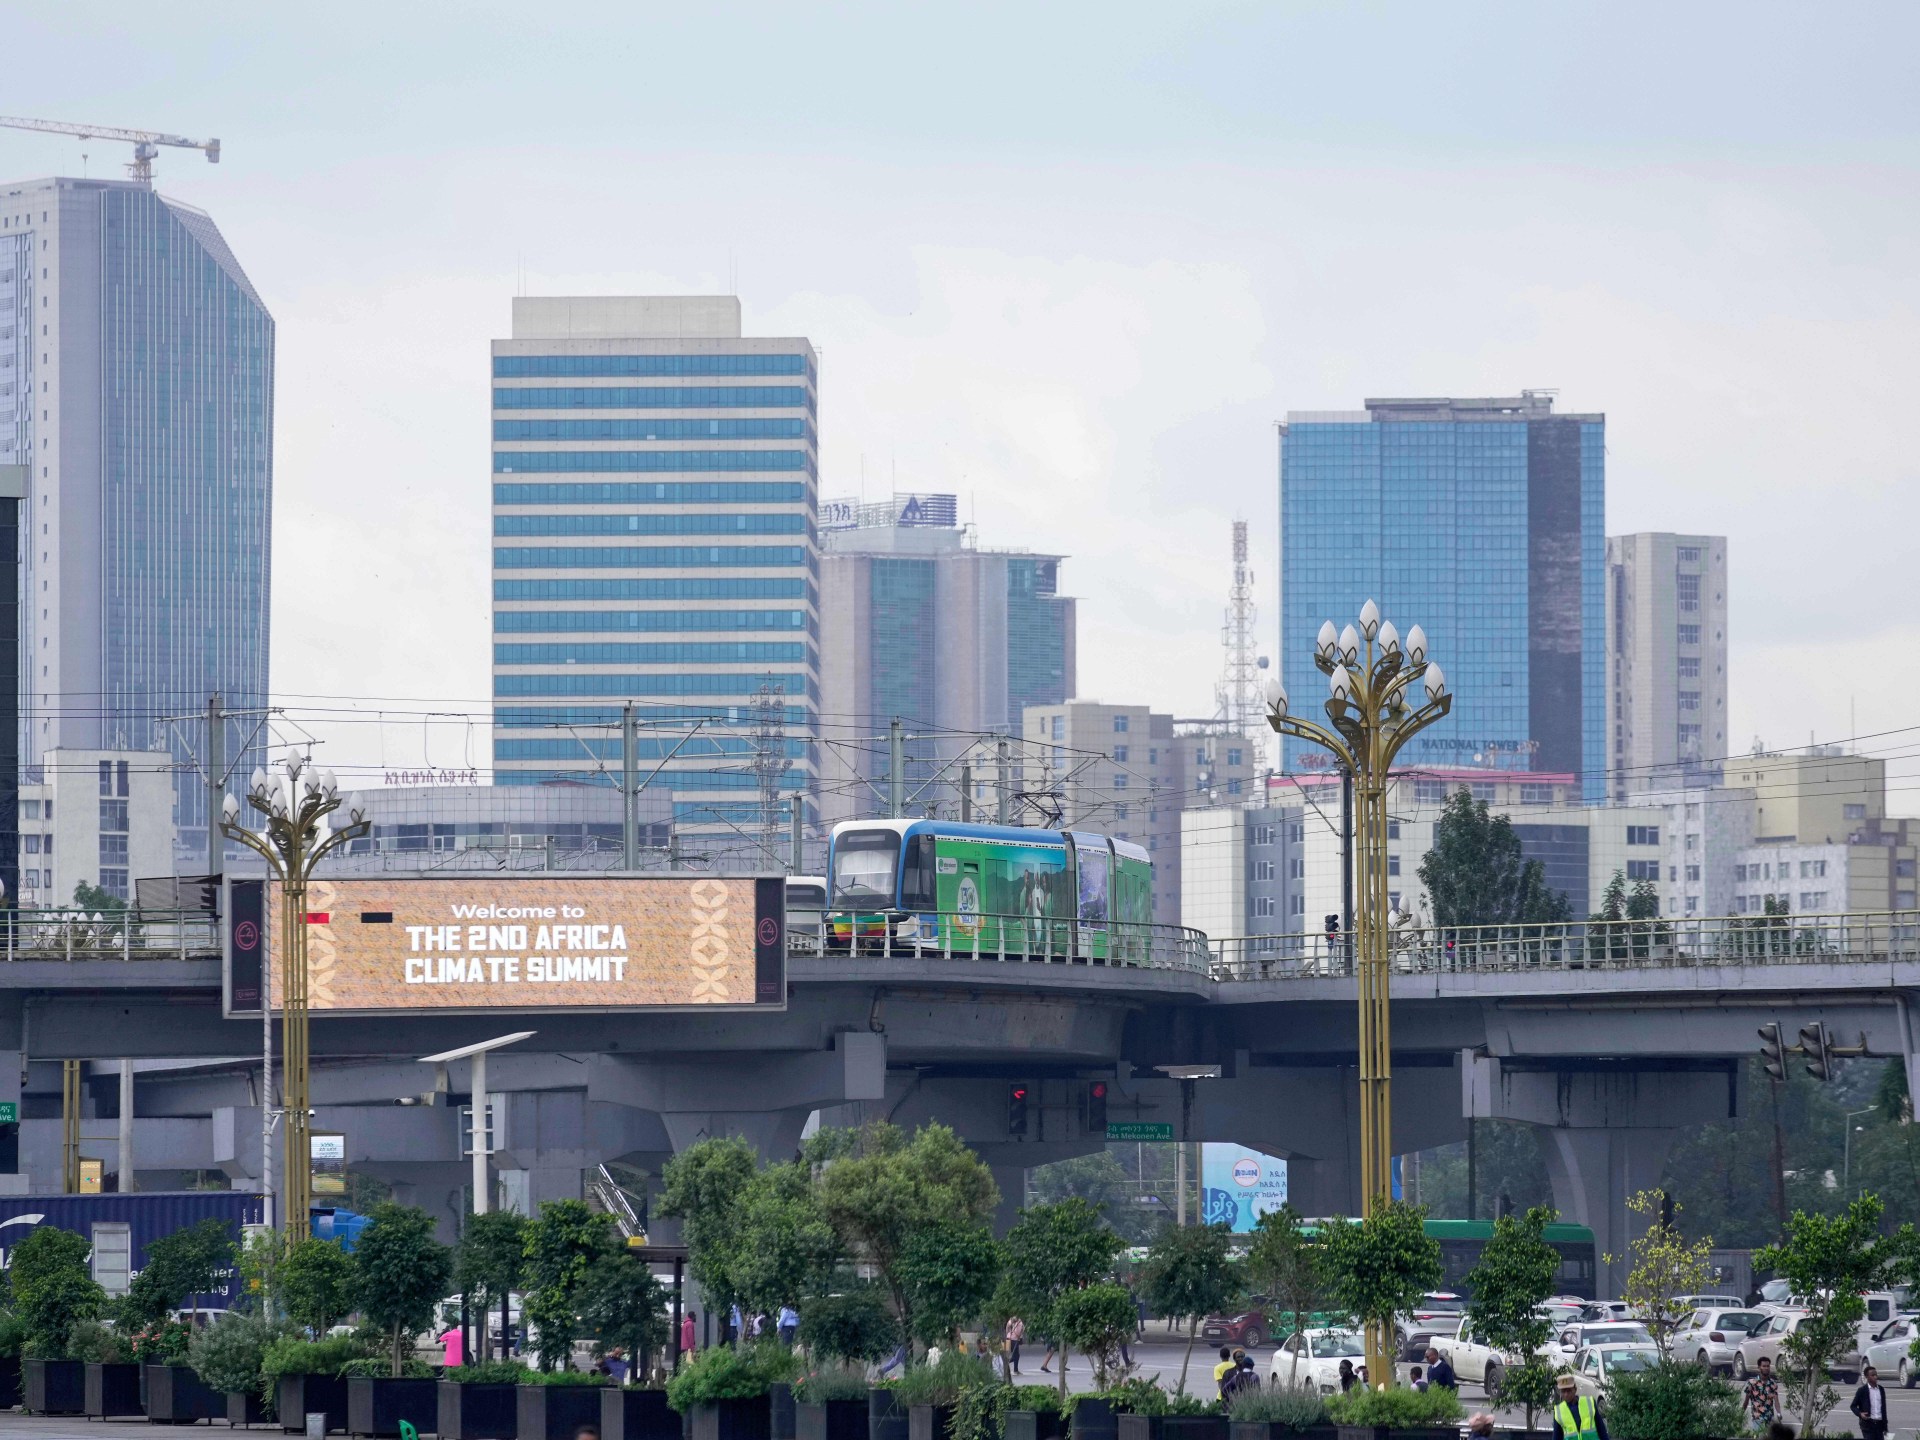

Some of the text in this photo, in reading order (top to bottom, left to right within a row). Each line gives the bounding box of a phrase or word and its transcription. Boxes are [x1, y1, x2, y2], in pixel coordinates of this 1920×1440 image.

[1421, 738, 1478, 751] NATIONAL
[1483, 739, 1519, 752] TOWER
[451, 904, 585, 919] Welcome to
[405, 925, 627, 951] THE 2ND AFRICA
[405, 957, 628, 983] CLIMATE SUMMIT
